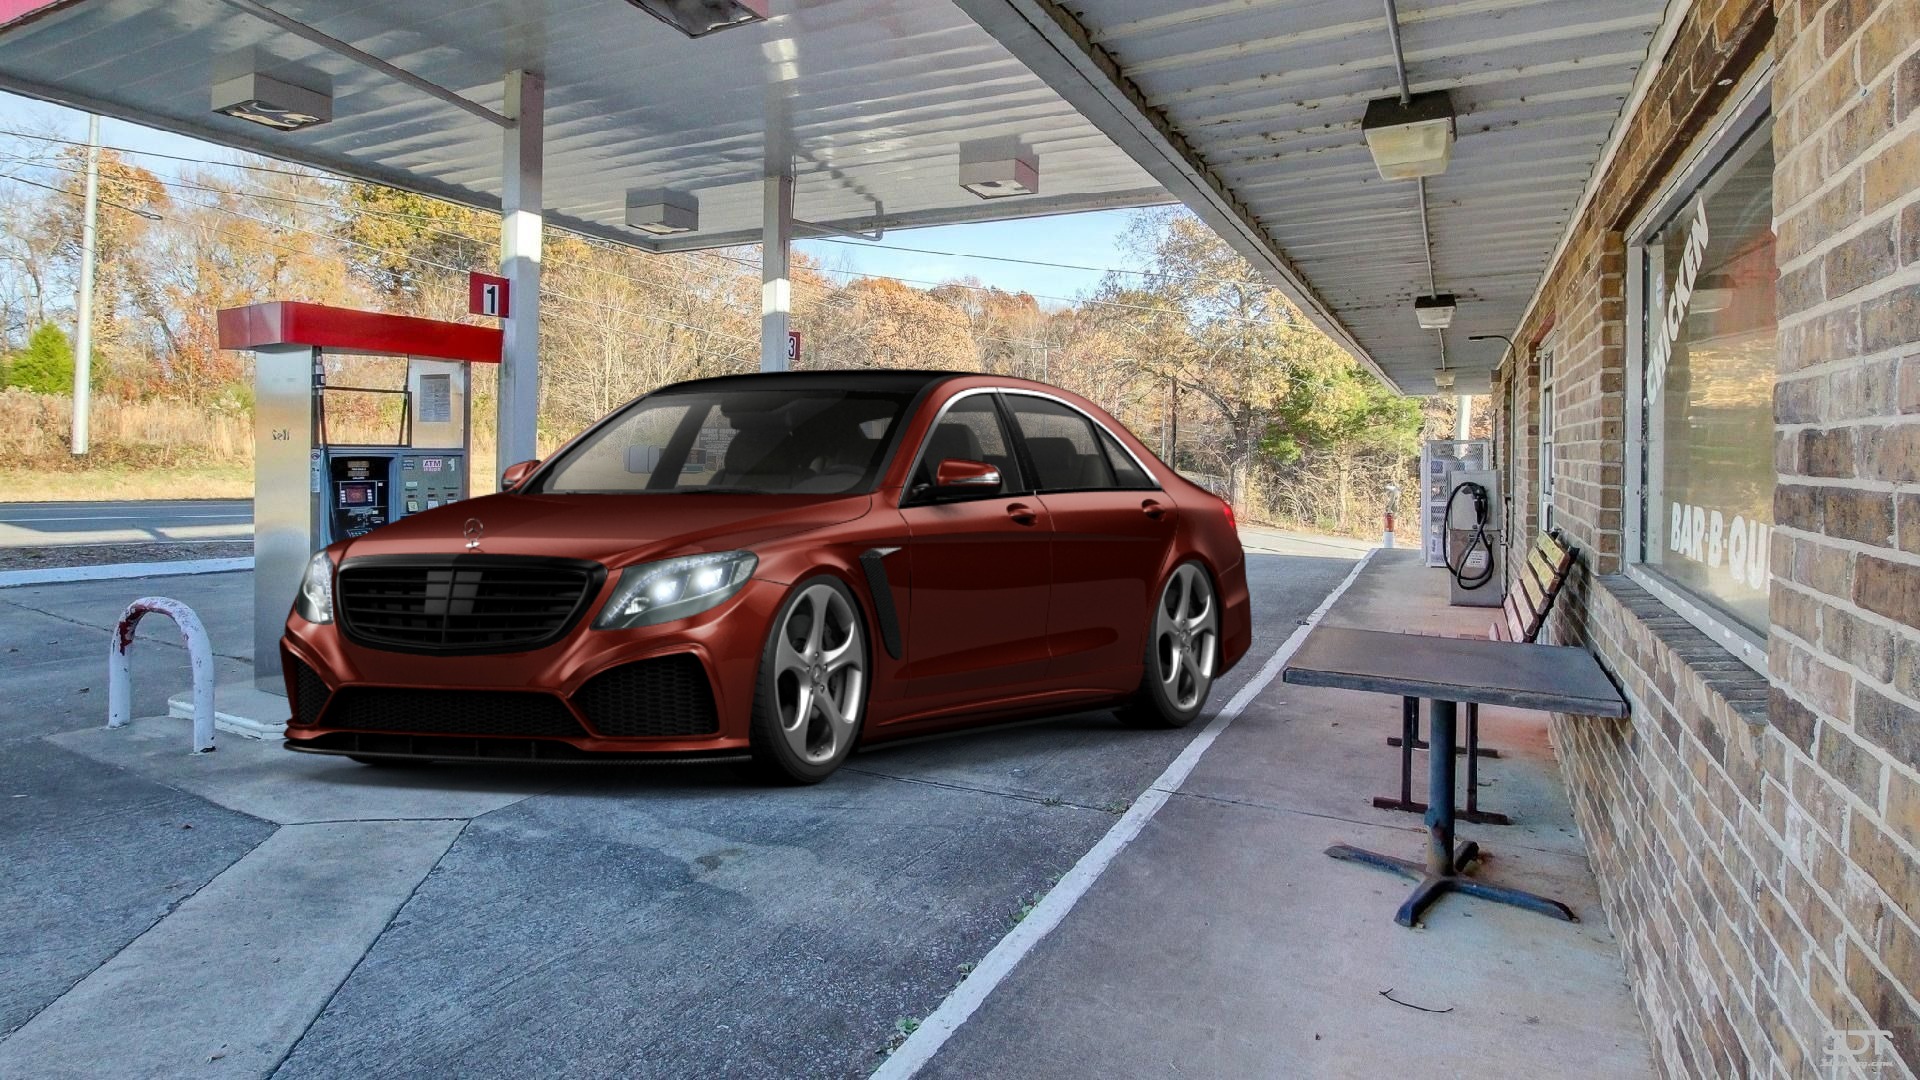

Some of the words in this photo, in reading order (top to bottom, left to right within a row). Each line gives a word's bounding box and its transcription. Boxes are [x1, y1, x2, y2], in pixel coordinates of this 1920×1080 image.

[486, 286, 496, 314] 1
[1647, 196, 1708, 405] CHICKEN
[789, 338, 796, 357] 3
[447, 458, 455, 471] 1
[1670, 502, 1774, 590] BAR-B-QU
